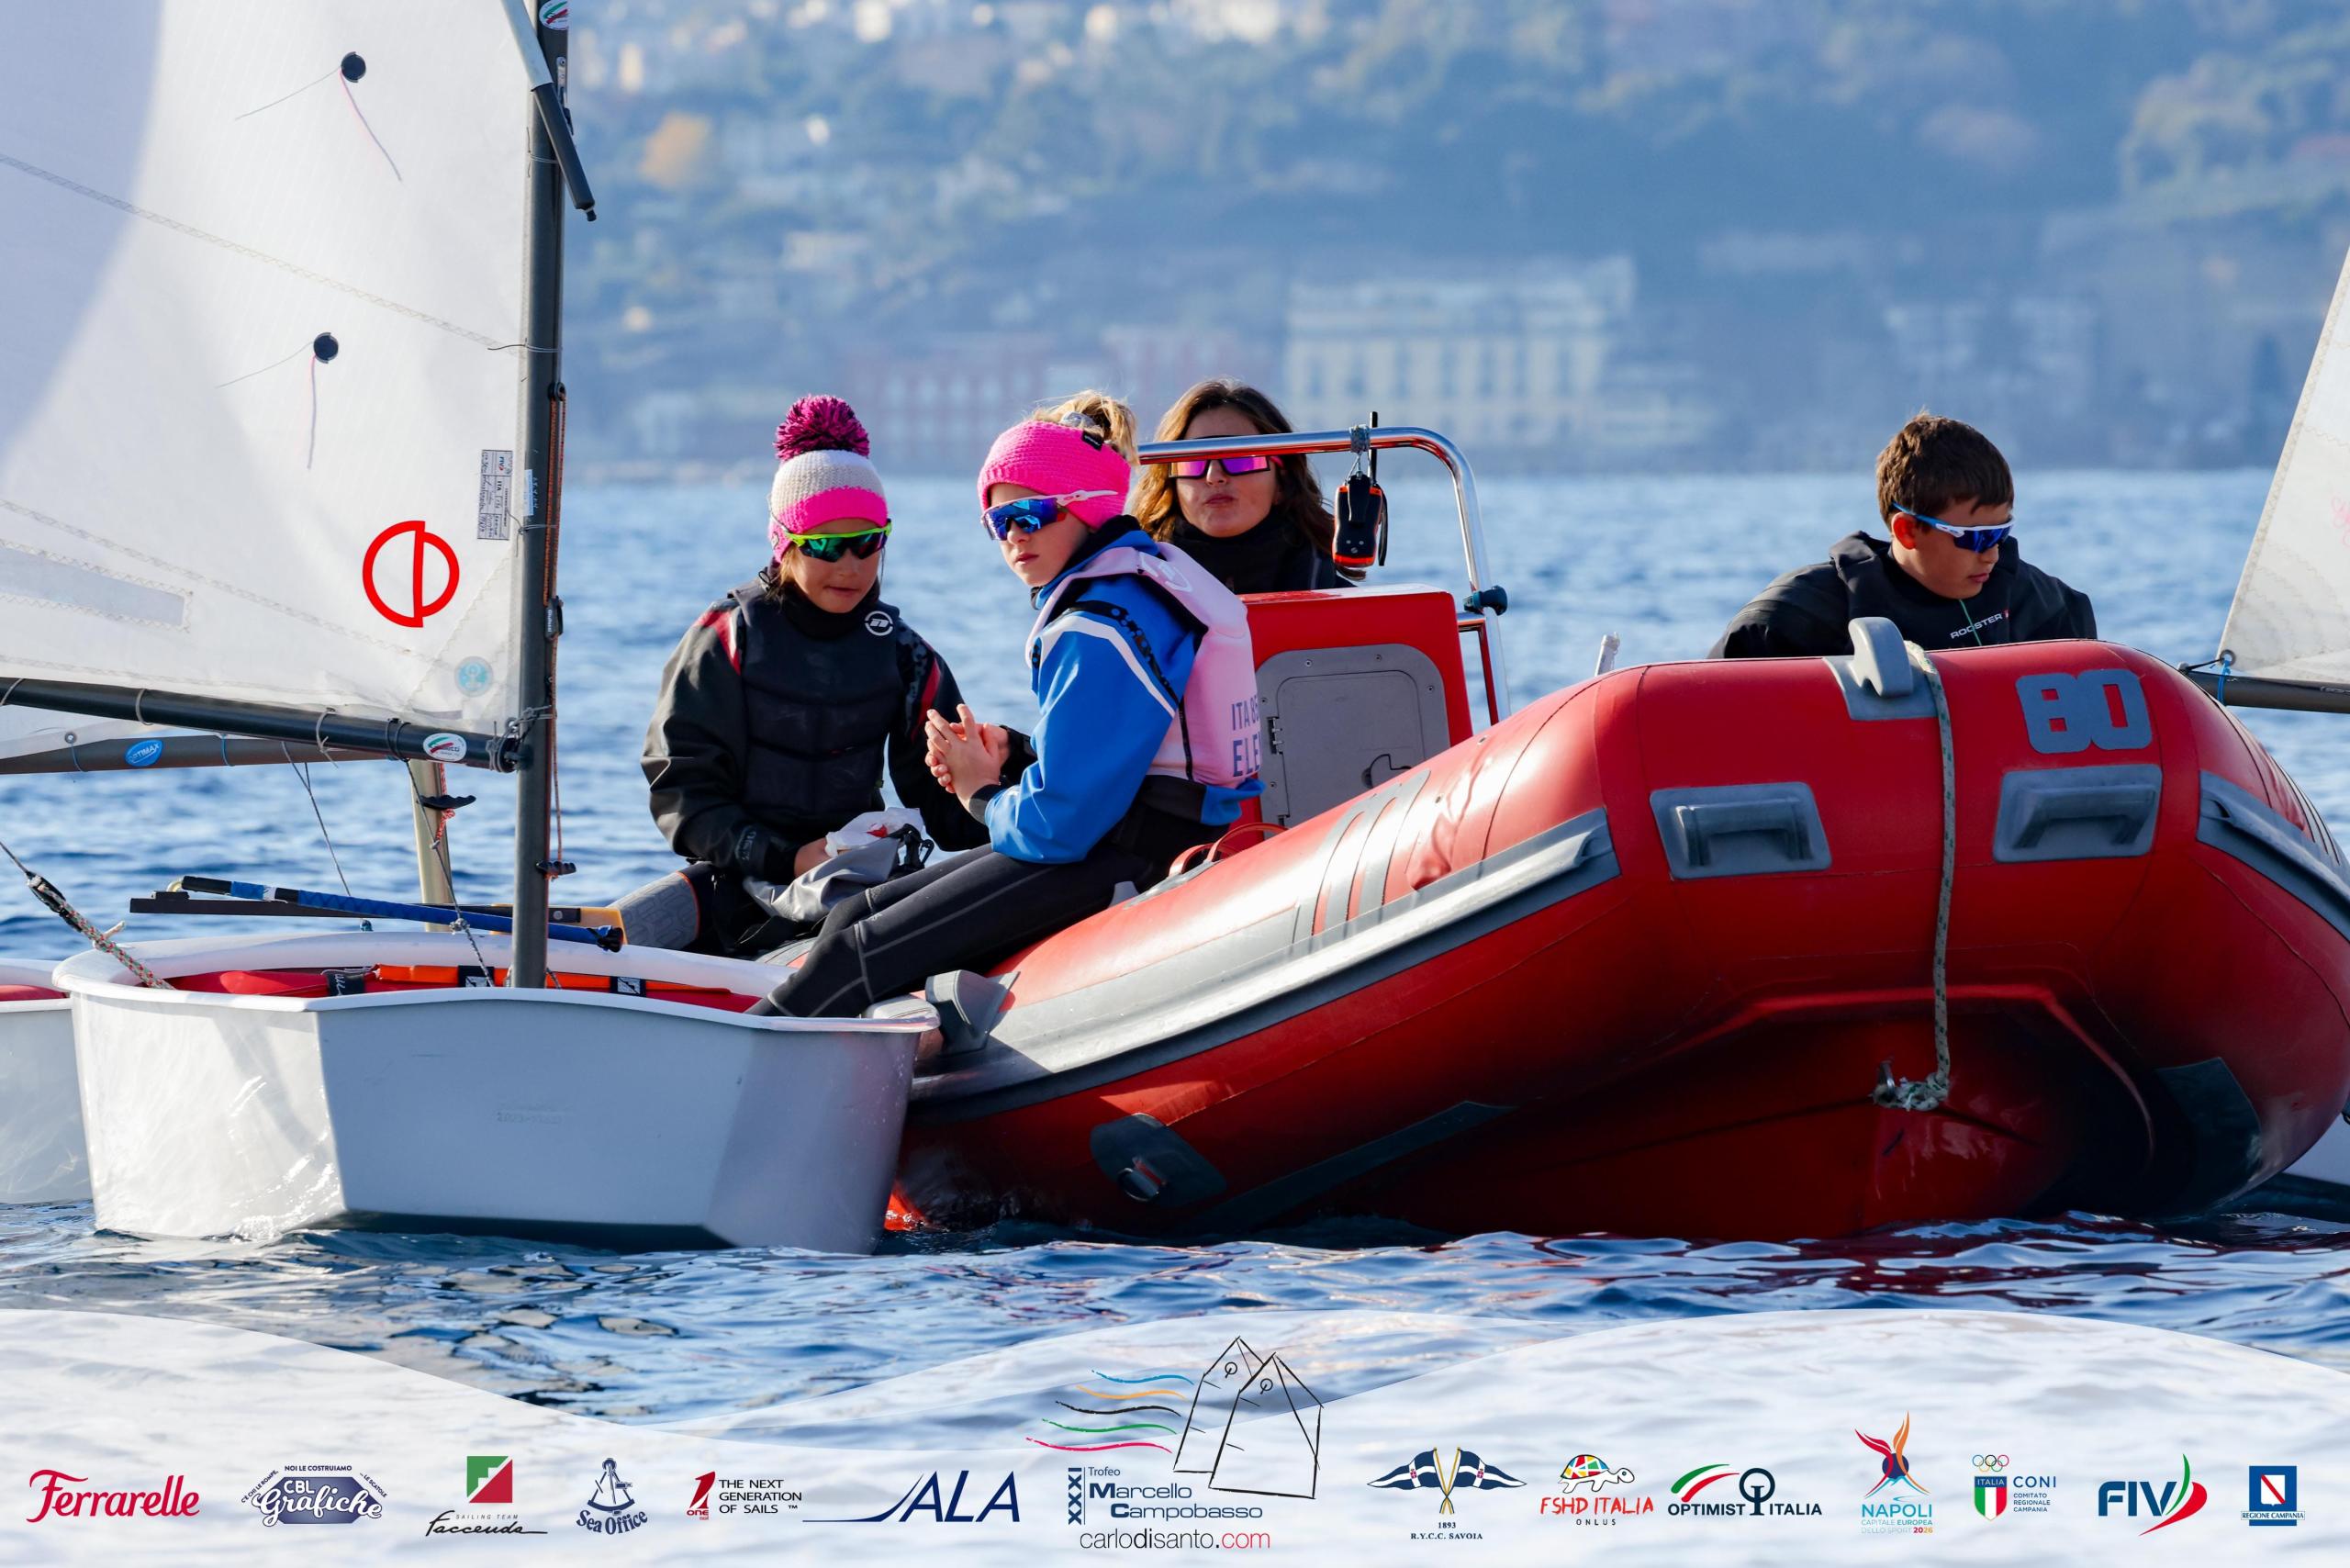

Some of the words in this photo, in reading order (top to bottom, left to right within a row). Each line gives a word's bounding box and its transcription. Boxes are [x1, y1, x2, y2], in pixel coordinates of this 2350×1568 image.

[1950, 613, 2003, 639] ROOSTER
[1232, 700, 1249, 731] ITA
[2015, 668, 2153, 754] 80
[1233, 732, 1261, 778] ELE
